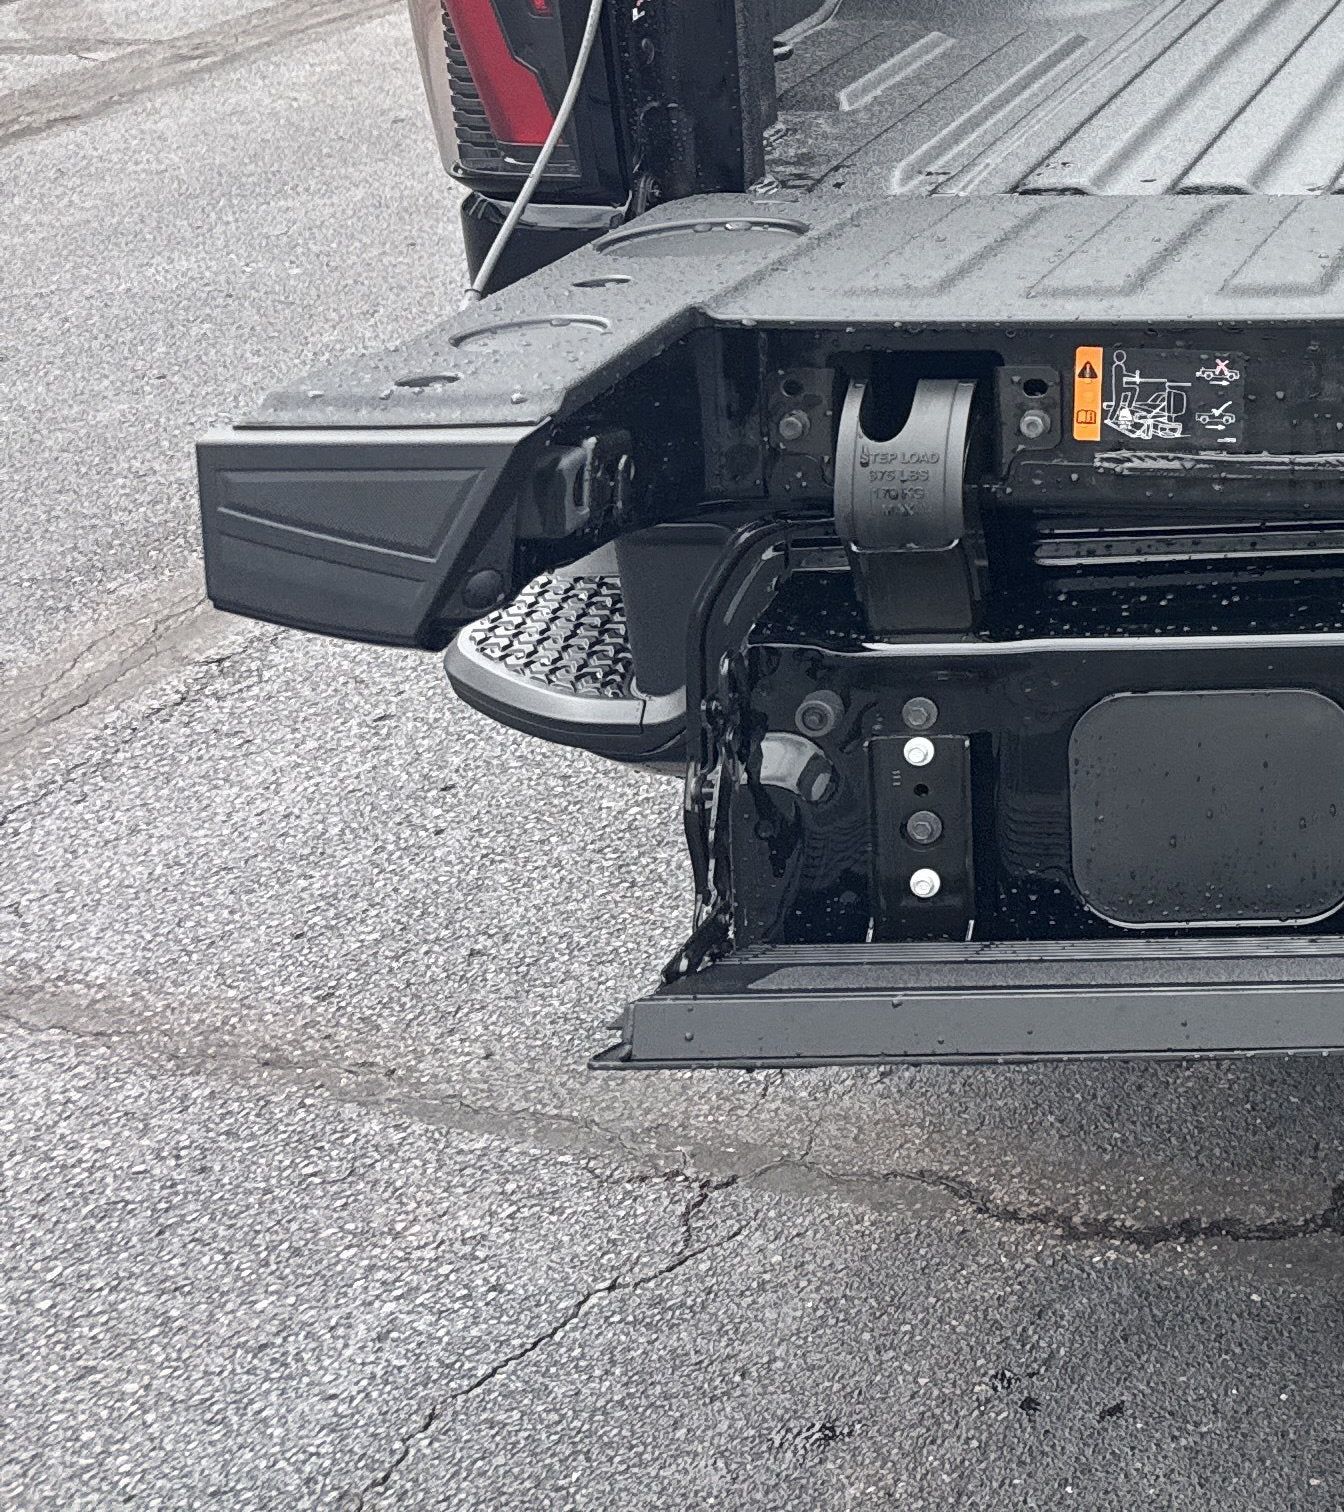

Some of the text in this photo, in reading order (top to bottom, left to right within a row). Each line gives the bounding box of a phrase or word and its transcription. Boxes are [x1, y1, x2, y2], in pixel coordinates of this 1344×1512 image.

[860, 451, 940, 466] STEP LOAD
[900, 469, 929, 483] LBS
